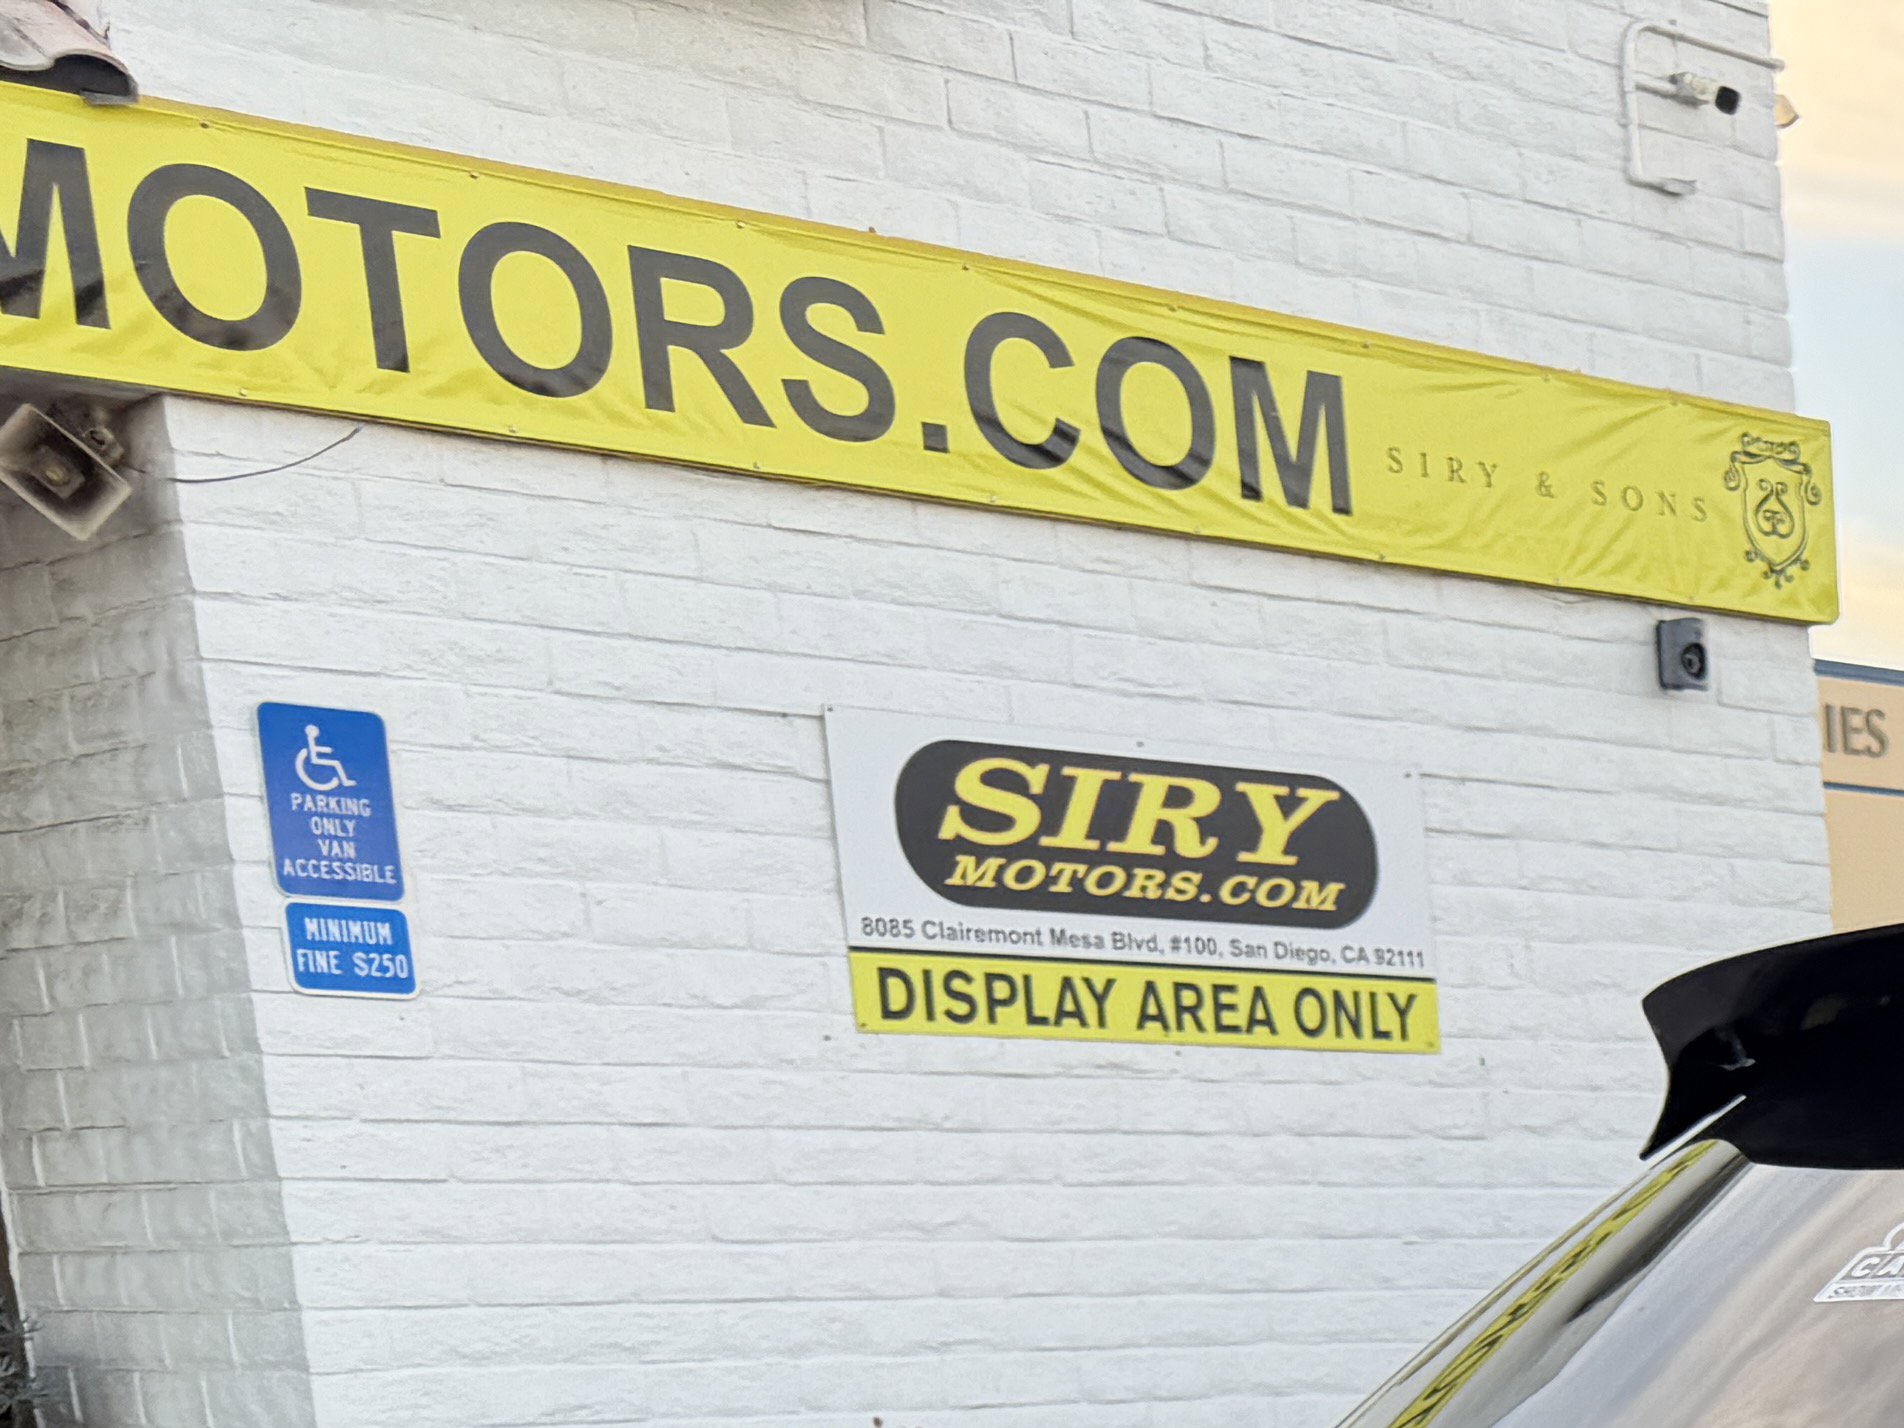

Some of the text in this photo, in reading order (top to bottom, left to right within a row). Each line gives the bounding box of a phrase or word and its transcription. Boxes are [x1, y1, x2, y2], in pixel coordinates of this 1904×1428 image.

[1387, 446, 1708, 523] SIRY & SONS
[290, 792, 372, 817] PARKING
[937, 756, 1341, 865] SIRY
[310, 816, 356, 837] ONLY
[317, 838, 357, 859] VAN
[282, 858, 398, 884] ACCESSIBLE
[944, 855, 1345, 911] MOTORS.COM
[304, 917, 393, 945] MINIMUM
[861, 916, 915, 939] 8085
[921, 919, 1043, 946] Clairemont
[1051, 928, 1105, 949] Mesa
[1111, 931, 1165, 956] Blvd,
[1170, 935, 1223, 959] #100,
[1229, 938, 1268, 959] San
[1341, 944, 1369, 966] CA
[1374, 947, 1426, 969] 92111
[297, 949, 342, 975] FINE
[876, 966, 1418, 1042] DISPLAY AREA ONLY
